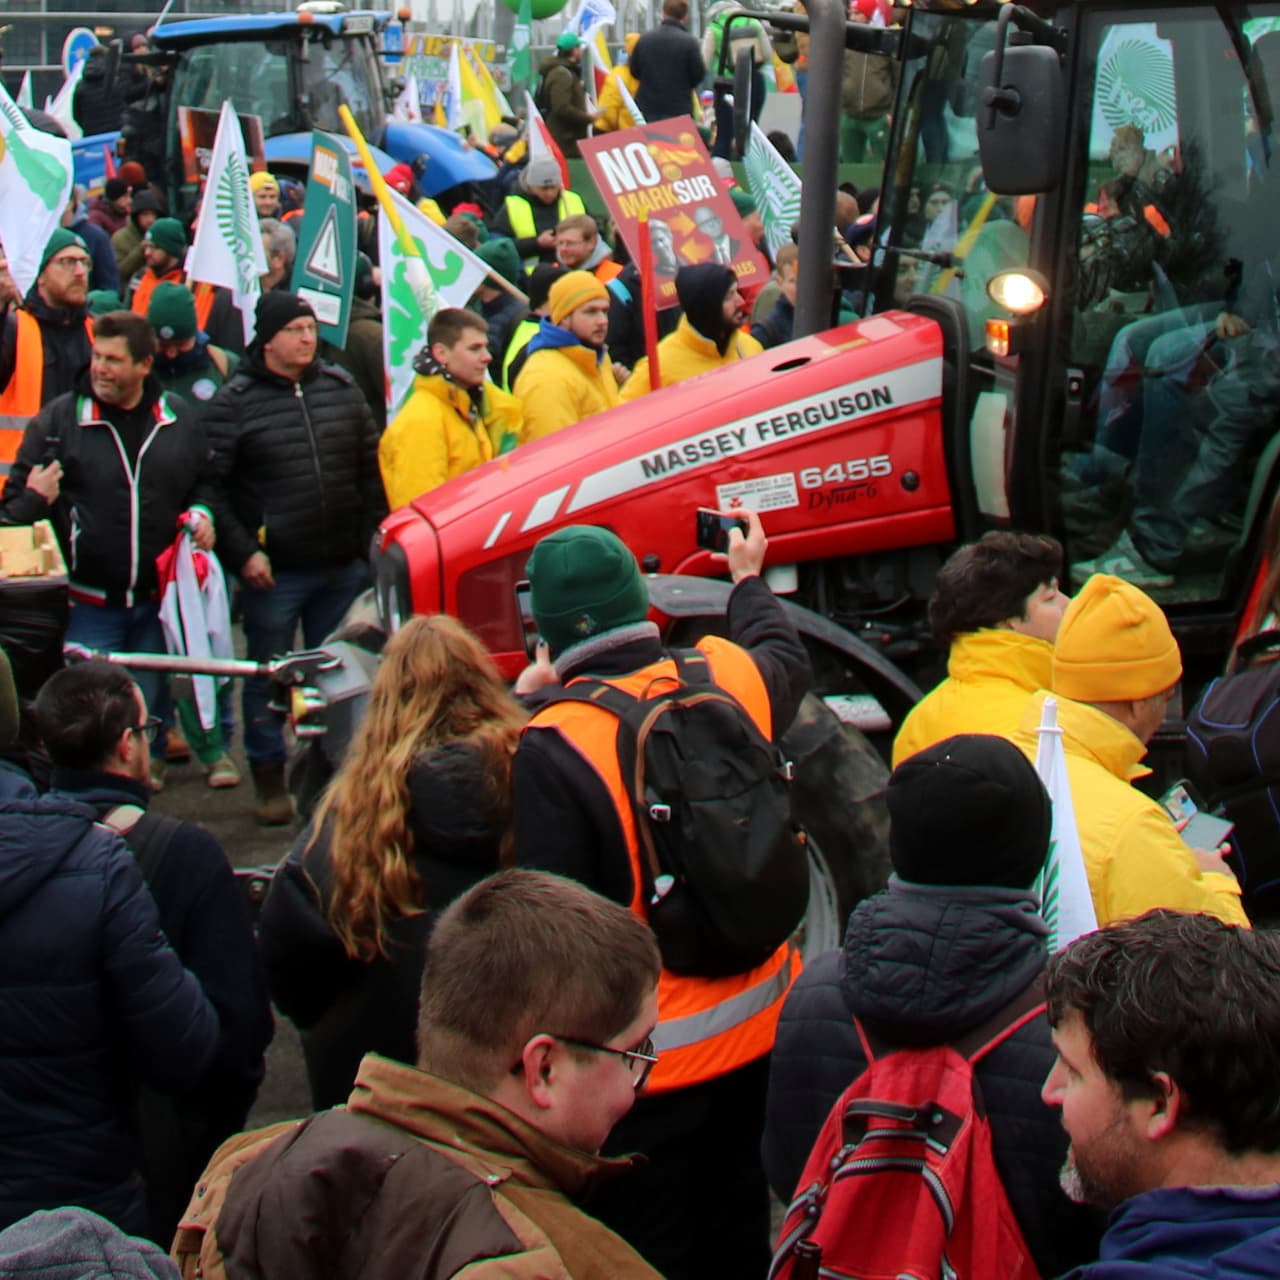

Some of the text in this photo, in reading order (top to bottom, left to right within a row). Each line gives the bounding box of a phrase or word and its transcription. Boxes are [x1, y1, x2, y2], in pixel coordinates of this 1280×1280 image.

[596, 141, 661, 195] NO
[617, 174, 718, 220] MARKSUR
[639, 384, 894, 480] MASSEY FERGUSON
[799, 454, 893, 490] 6455
[808, 483, 879, 513] Dyna-6
